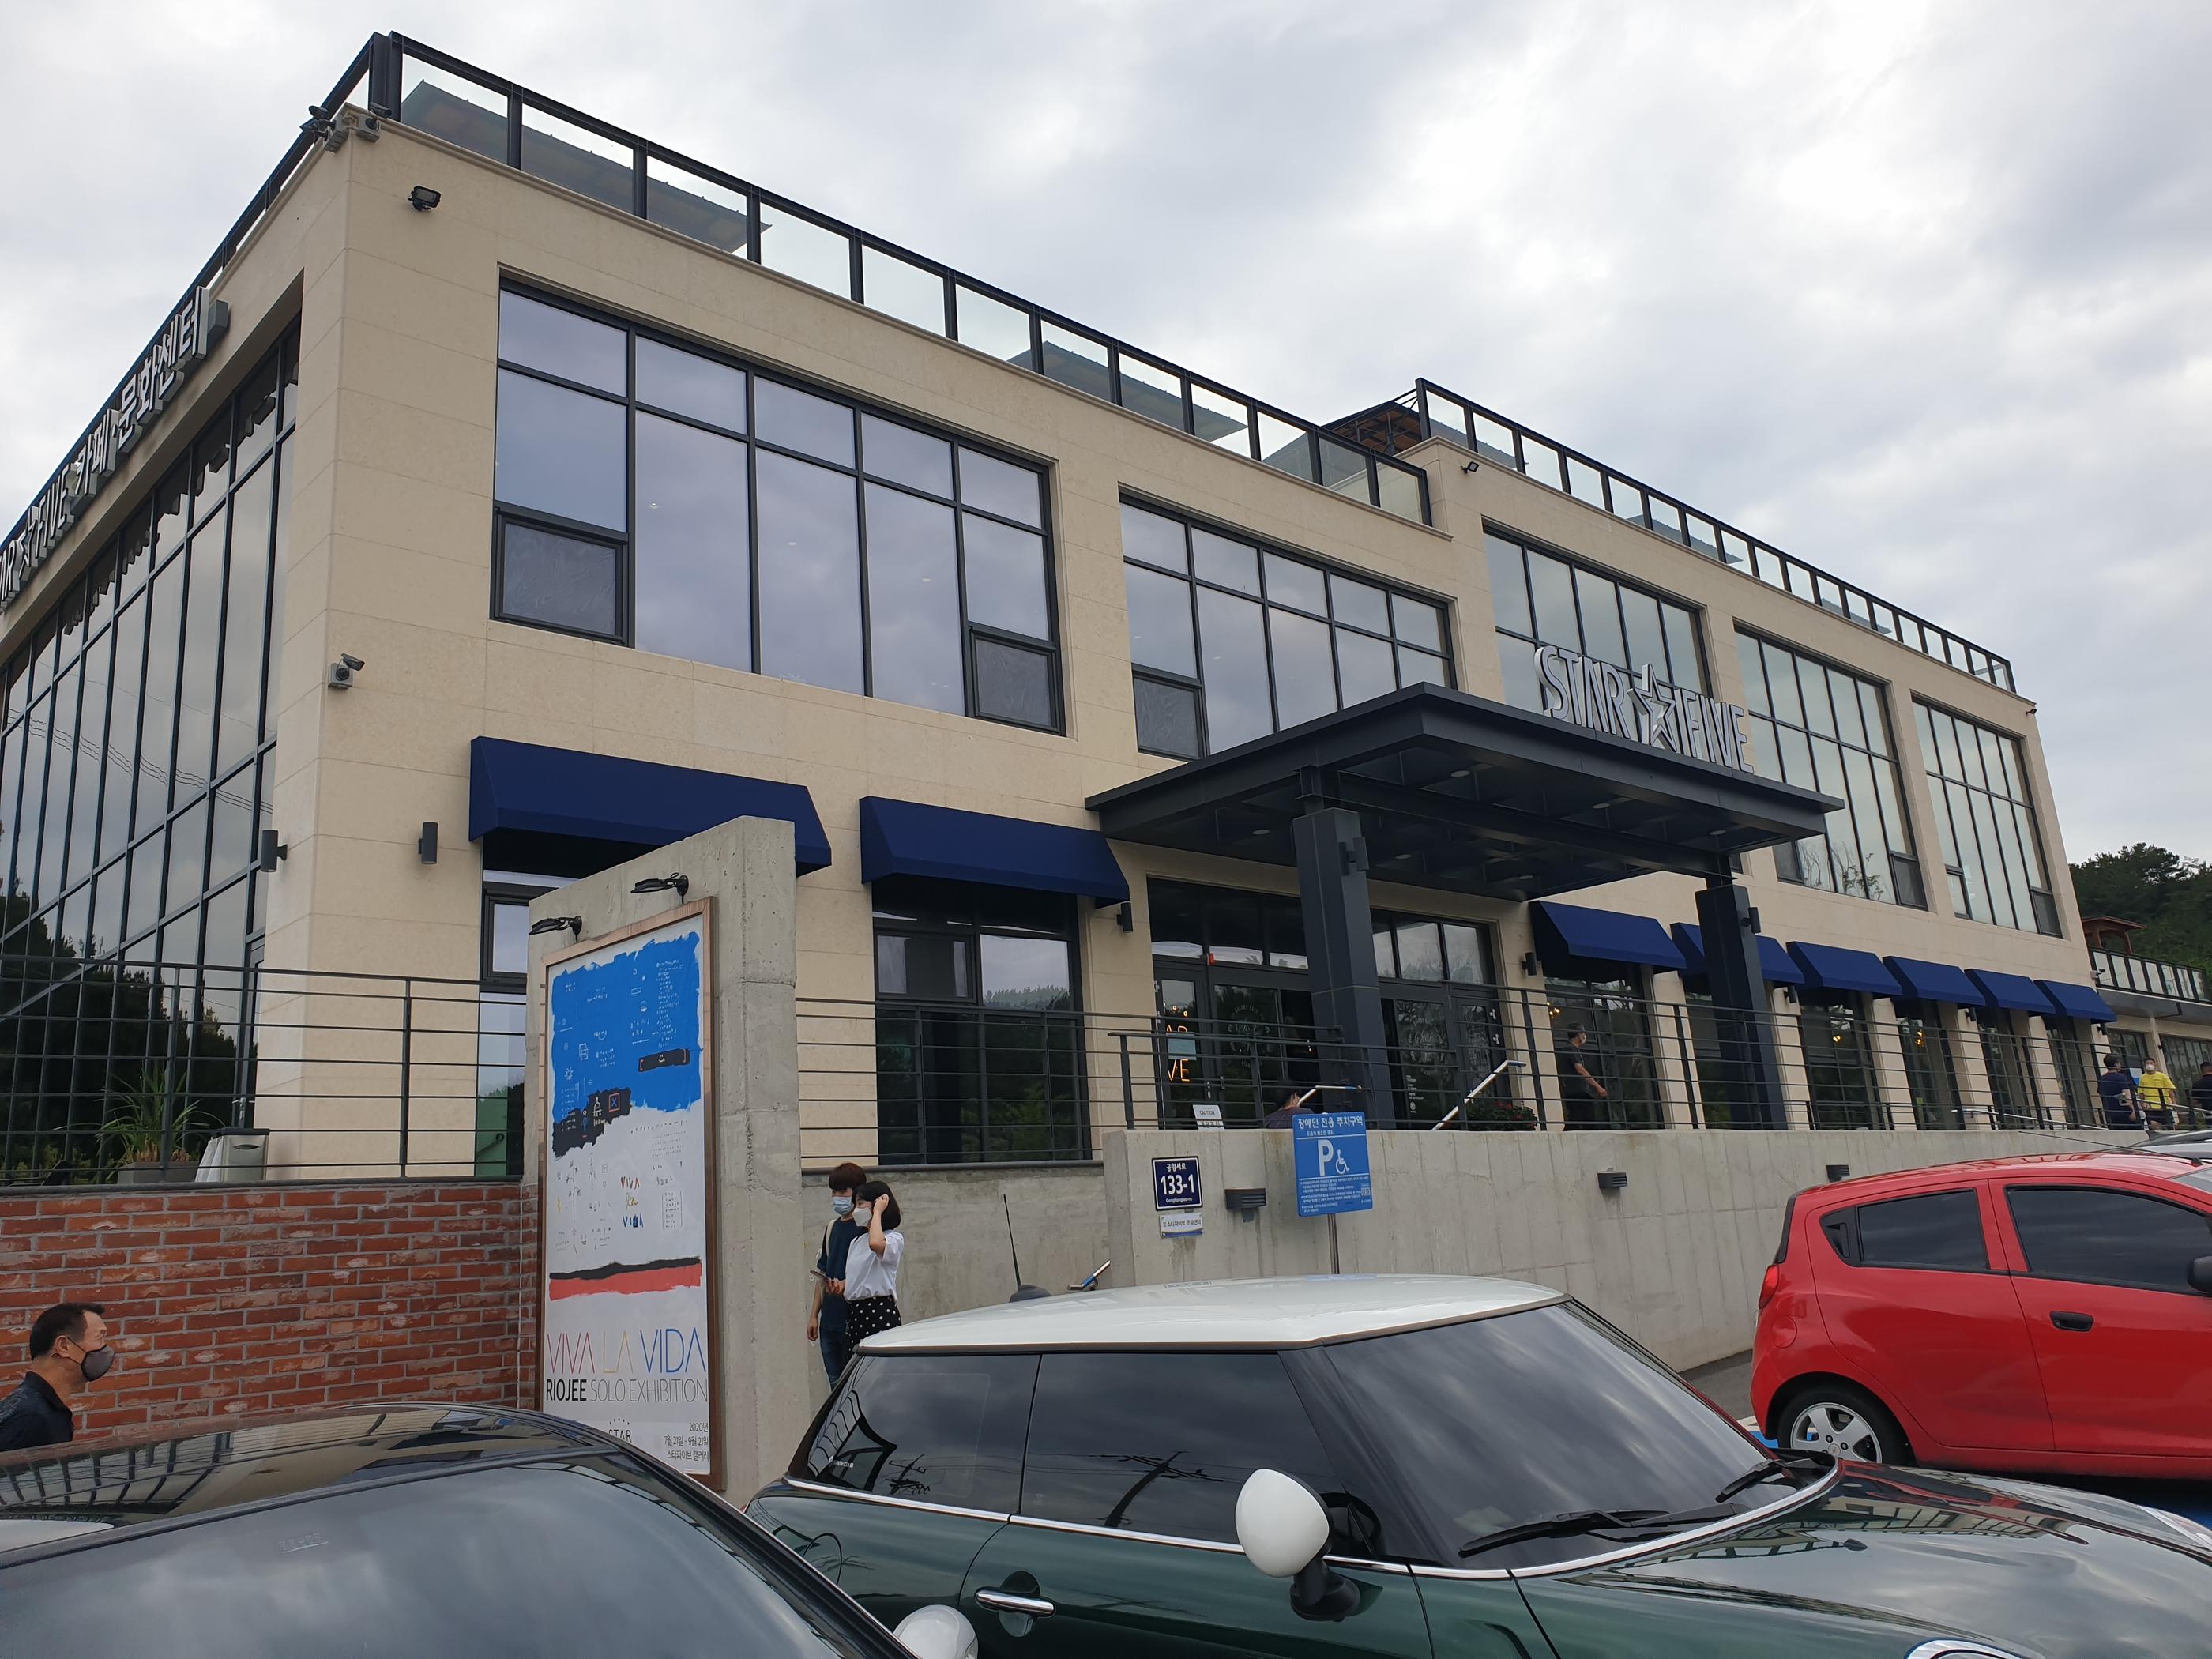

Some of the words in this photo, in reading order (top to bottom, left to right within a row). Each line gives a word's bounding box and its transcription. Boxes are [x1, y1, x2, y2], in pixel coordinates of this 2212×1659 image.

[35, 463, 71, 559] FIVE
[1535, 645, 1631, 739] STAR
[1676, 689, 1755, 774] FIVE
[1297, 1118, 1319, 1130] 장애인
[1321, 1116, 1334, 1128] 전용
[1337, 1115, 1364, 1127] 주차구역
[1317, 1139, 1334, 1176] P
[1166, 1162, 1187, 1172] 공항서로
[620, 1176, 640, 1189] VIVA
[1160, 1173, 1194, 1195] 133-1
[547, 1331, 595, 1374] VIVA
[603, 1330, 633, 1374] LA
[640, 1327, 706, 1373] VIDA
[546, 1379, 587, 1401] RIOJEE
[590, 1379, 626, 1402] SOLO
[629, 1379, 708, 1402] EXHIBITION
[689, 1422, 709, 1432] 2020년
[664, 1435, 672, 1446] 7월
[688, 1436, 697, 1446] 9월
[667, 1450, 692, 1460] 스타파이브
[693, 1450, 709, 1462] 갤러리
